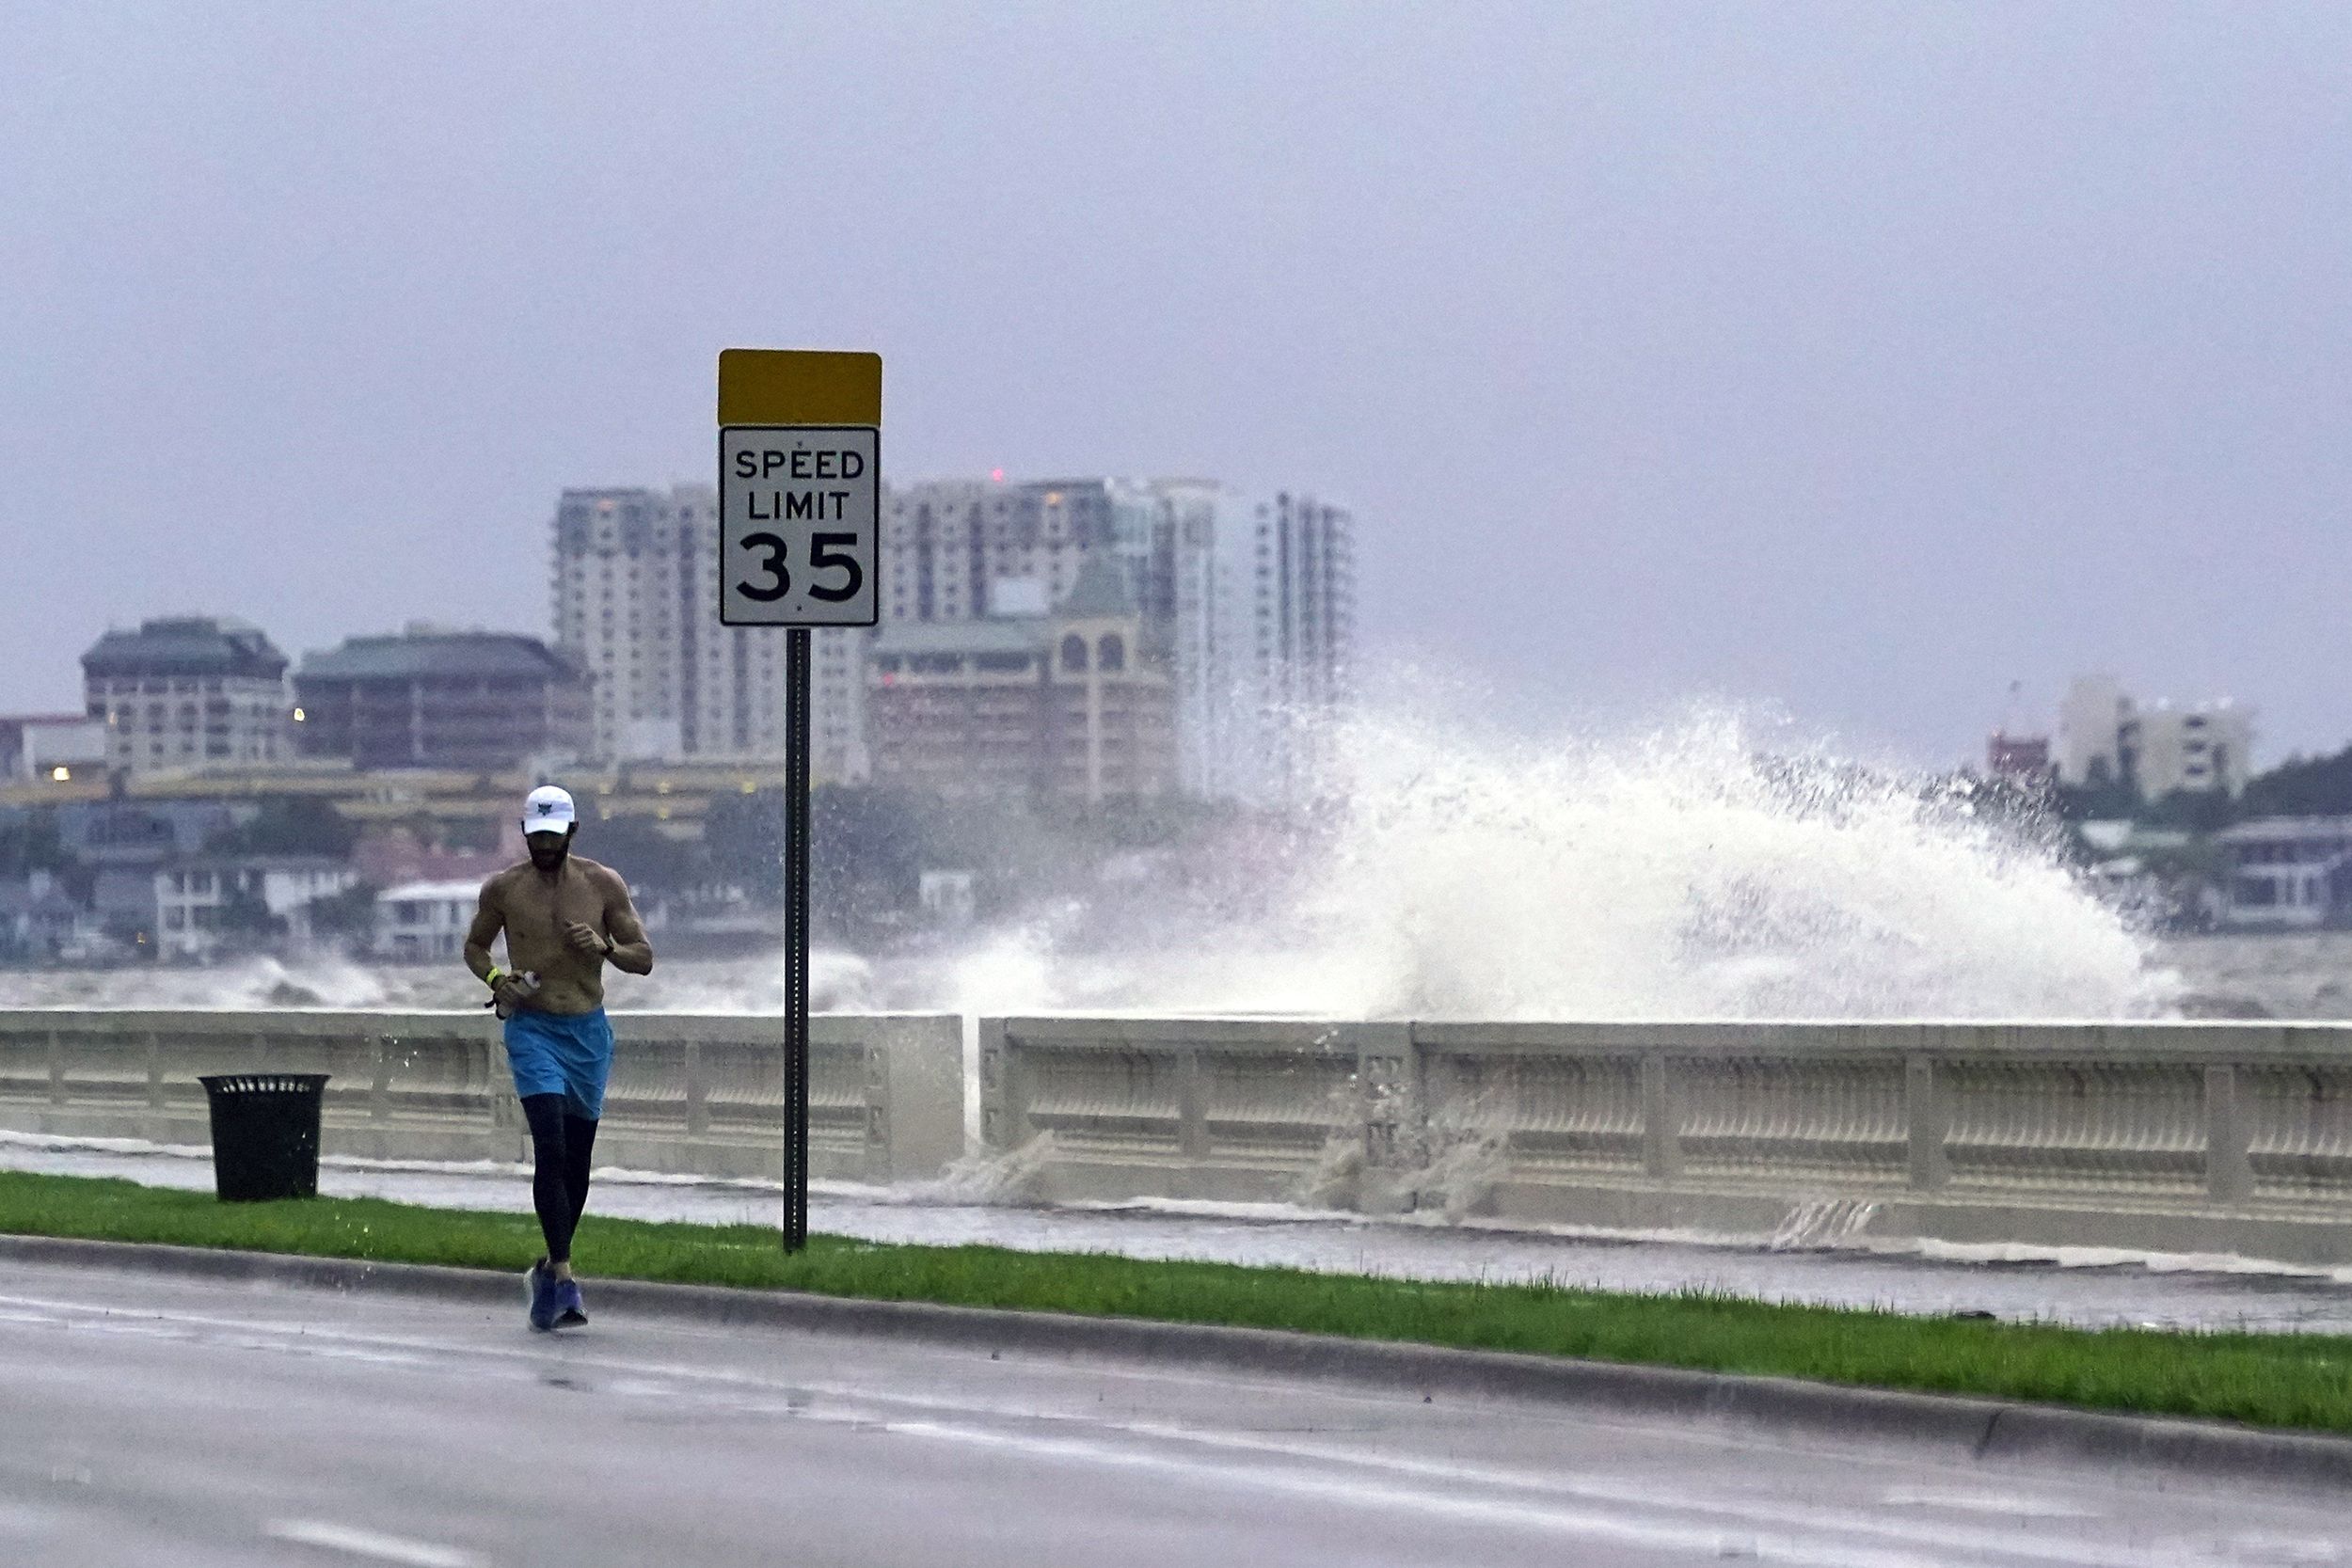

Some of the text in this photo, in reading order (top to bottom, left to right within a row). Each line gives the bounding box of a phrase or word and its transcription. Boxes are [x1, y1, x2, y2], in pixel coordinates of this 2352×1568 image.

[736, 451, 864, 479] SPEED
[749, 491, 850, 520] LIMIT
[736, 532, 863, 602] 35
